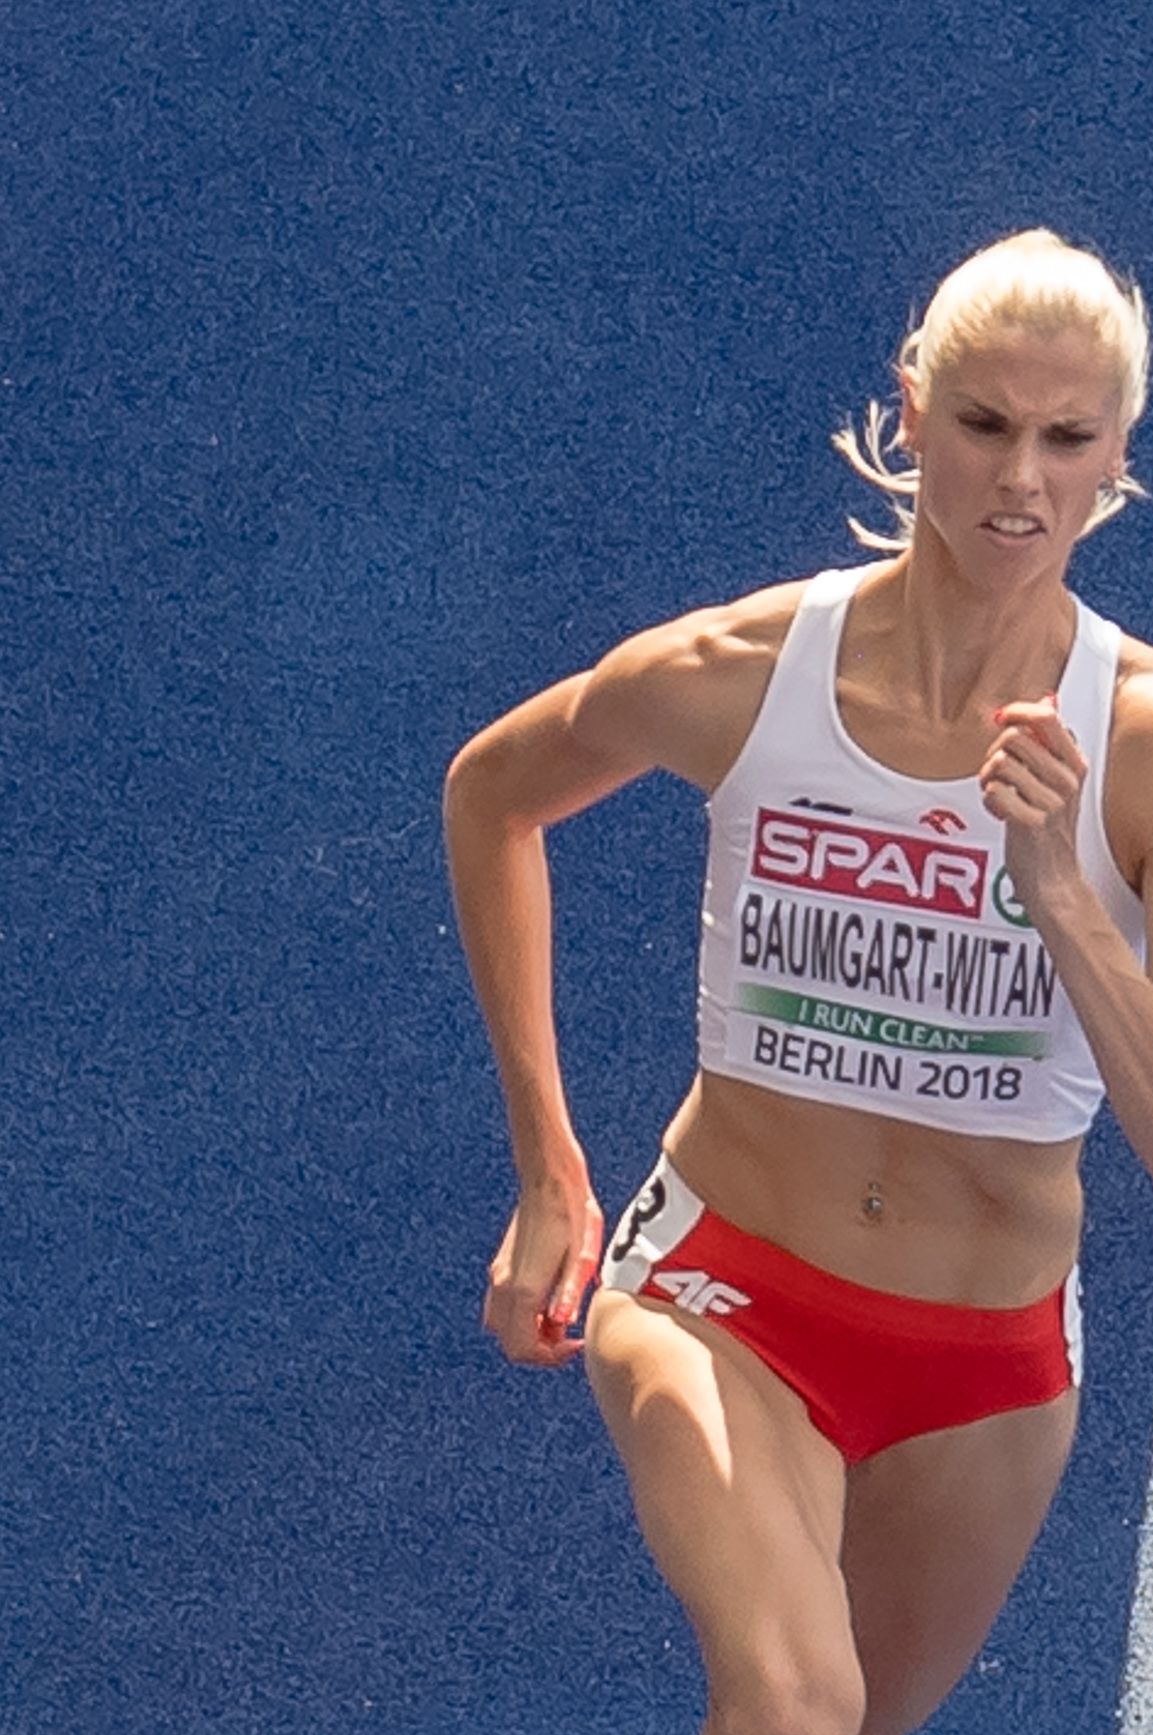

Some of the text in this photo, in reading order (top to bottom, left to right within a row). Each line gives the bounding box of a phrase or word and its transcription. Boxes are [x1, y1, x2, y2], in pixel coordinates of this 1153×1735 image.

[758, 820, 980, 907] SPAR
[740, 894, 1056, 1018] BAUMGART-WITAN
[813, 1004, 875, 1037] RUN
[754, 1025, 1022, 1101] BERLIN 2018
